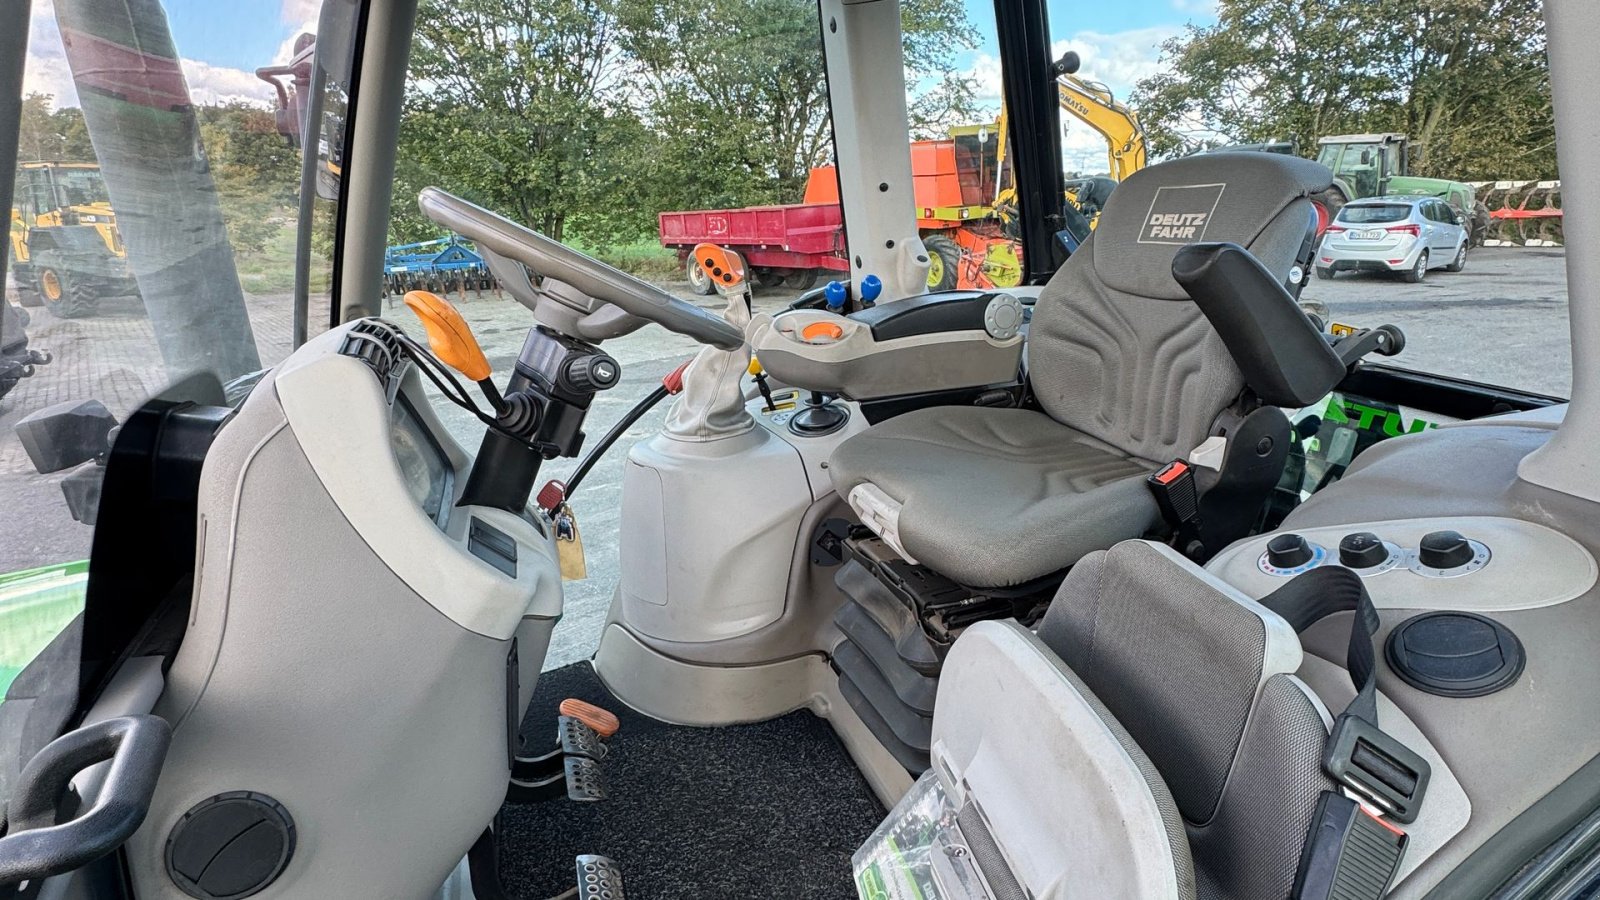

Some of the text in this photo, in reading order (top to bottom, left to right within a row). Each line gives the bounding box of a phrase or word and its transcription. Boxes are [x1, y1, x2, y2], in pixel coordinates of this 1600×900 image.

[1059, 92, 1089, 116] OMATSU
[1149, 213, 1207, 226] DEUTZ
[1149, 226, 1196, 239] FAHR
